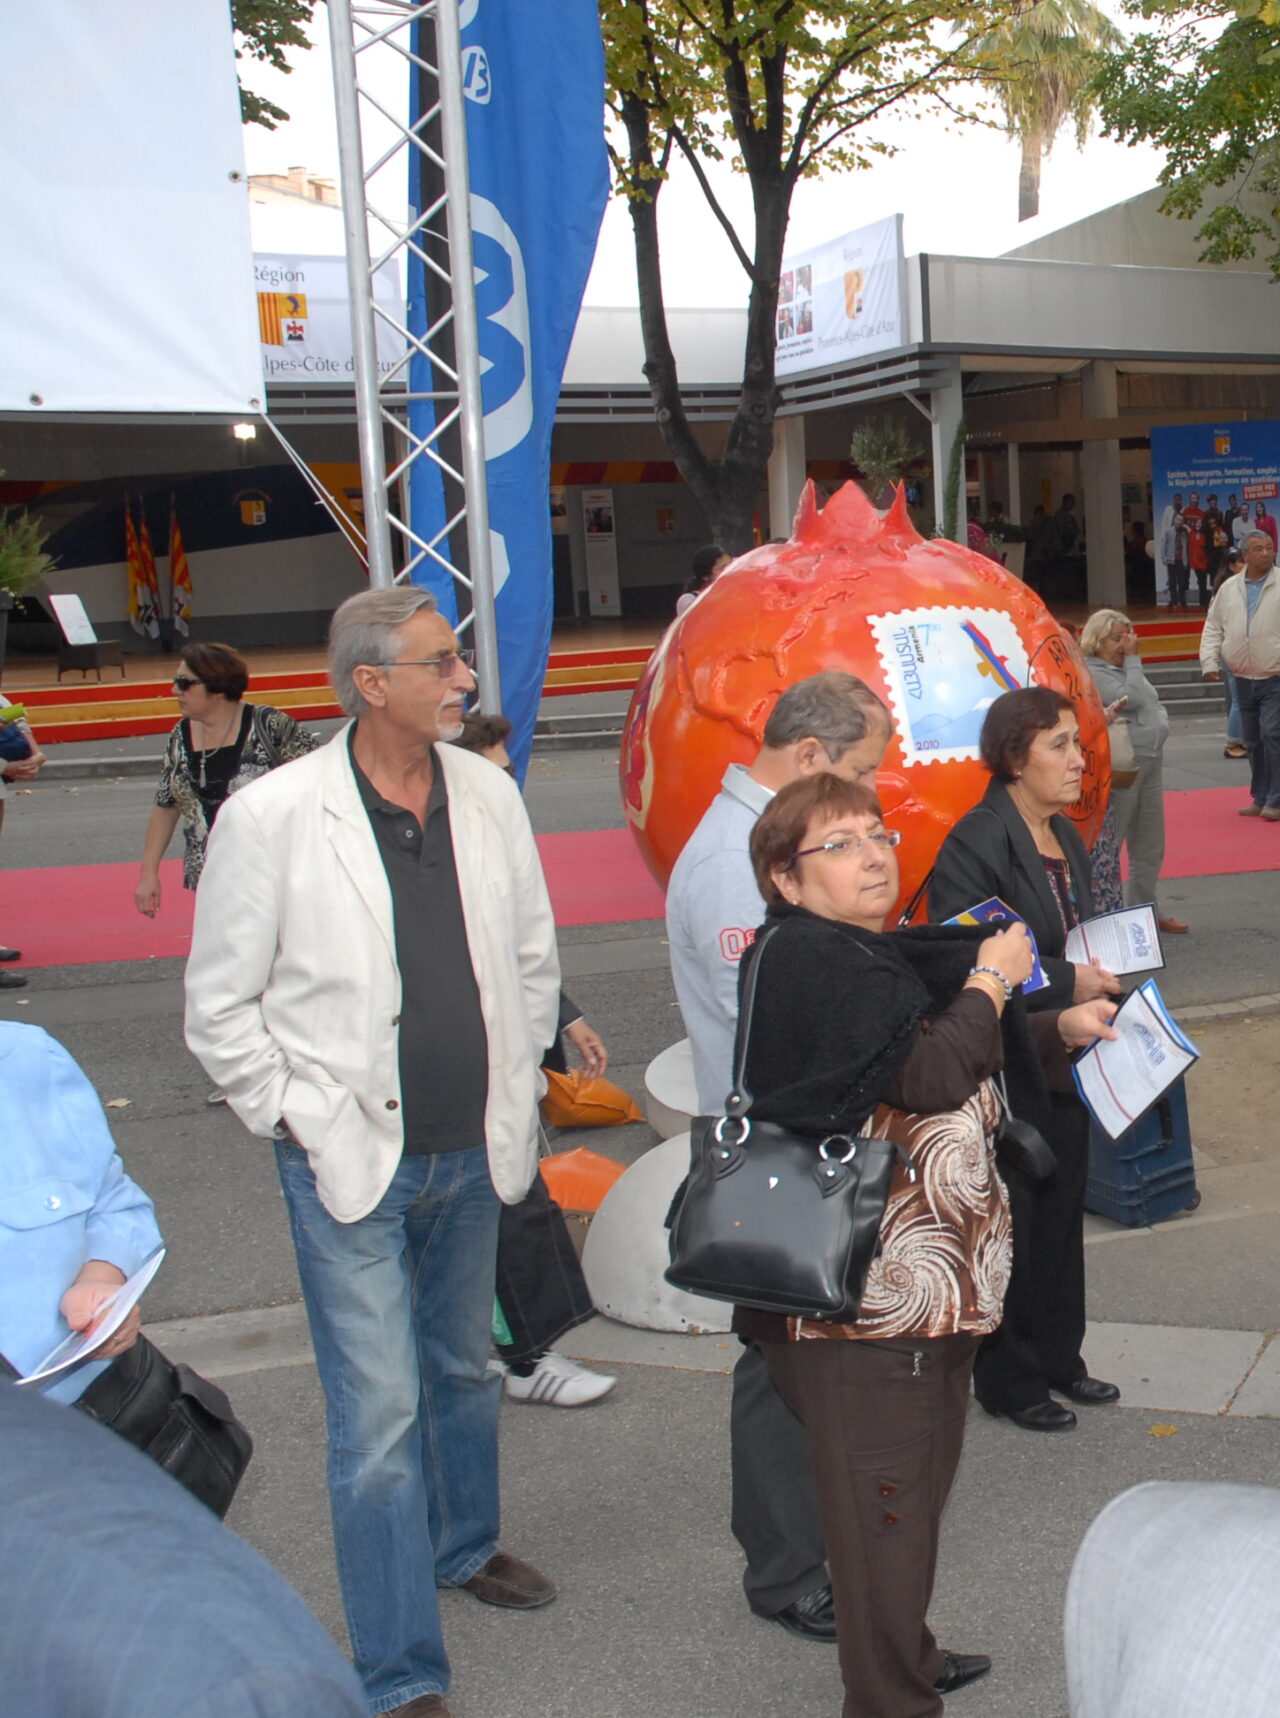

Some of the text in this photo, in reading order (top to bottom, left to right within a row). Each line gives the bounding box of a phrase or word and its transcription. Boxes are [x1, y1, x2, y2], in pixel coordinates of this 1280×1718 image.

[263, 355, 343, 374] lpes-Côte
[908, 625, 925, 664] Armenia
[915, 738, 940, 751] 2010
